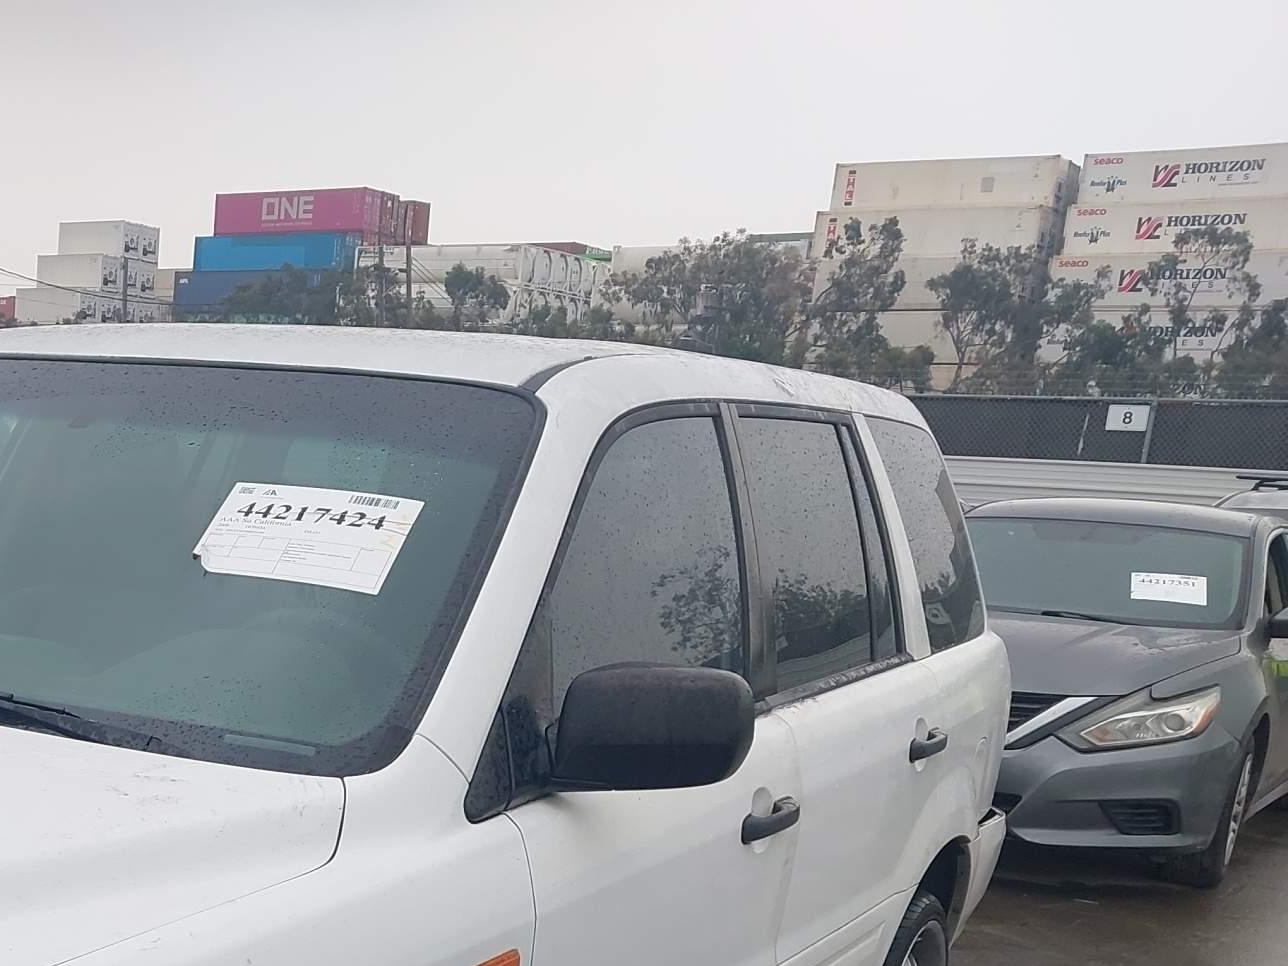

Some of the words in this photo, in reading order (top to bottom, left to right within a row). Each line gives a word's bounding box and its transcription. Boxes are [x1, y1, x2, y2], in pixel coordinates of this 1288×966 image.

[1094, 157, 1123, 165] seaco
[1184, 159, 1266, 174] HORIZON
[1182, 173, 1250, 183] LINES
[262, 195, 314, 220] ONE
[1077, 208, 1107, 217] seaco
[1166, 213, 1248, 227] HORIZON
[1058, 259, 1089, 268] seaco
[1122, 411, 1133, 425] 8
[237, 502, 386, 530] 44217424
[253, 518, 292, 528] California
[1138, 578, 1196, 587] 44217351
